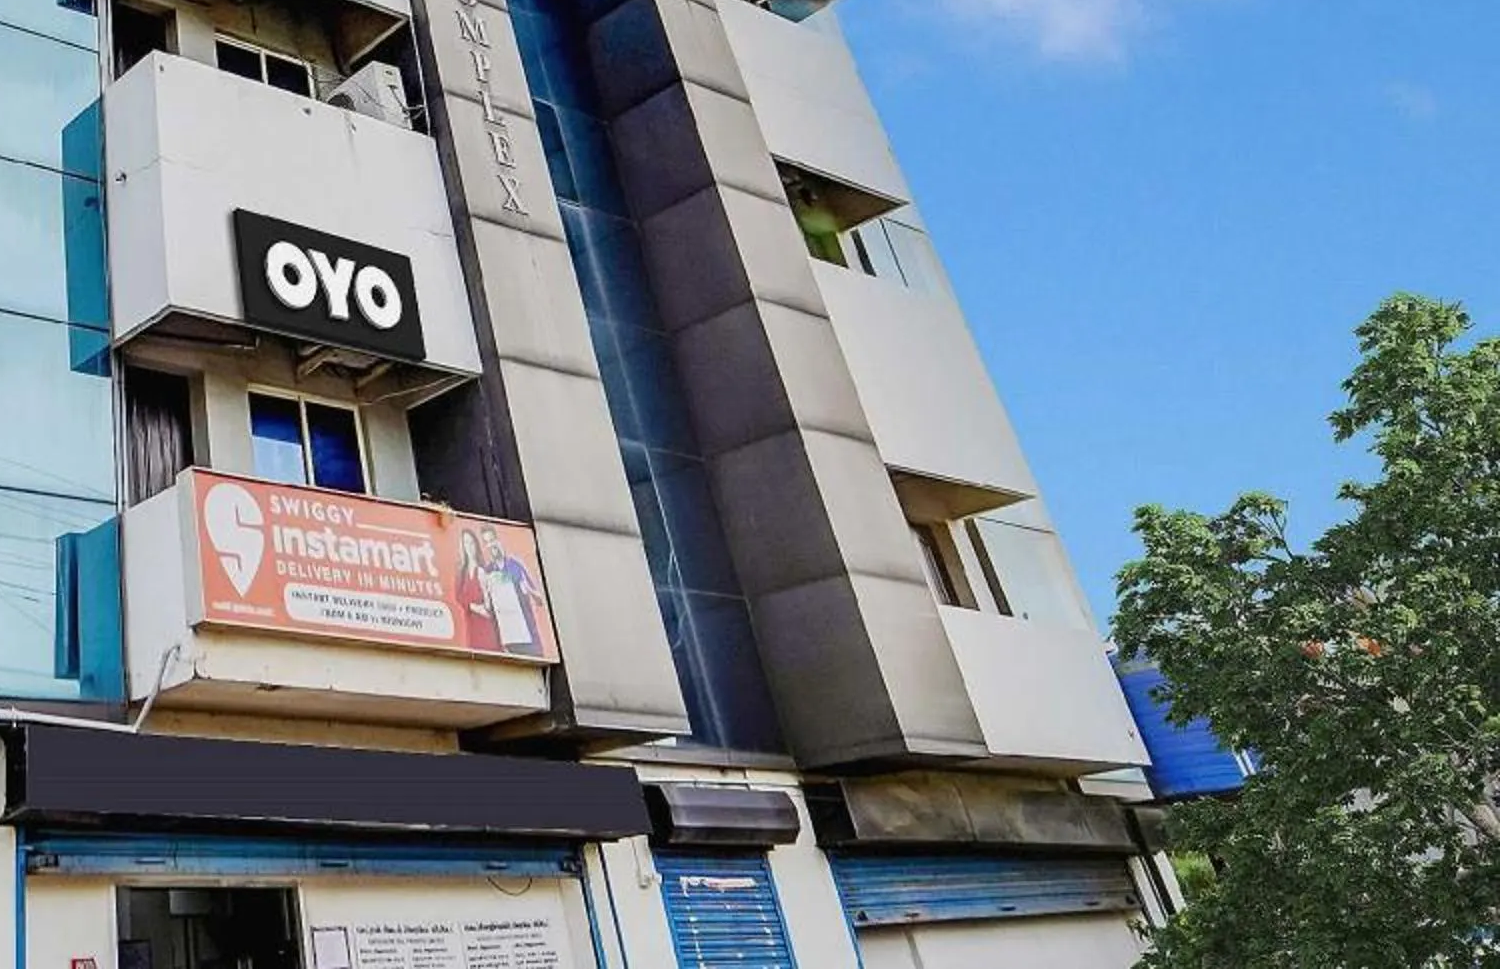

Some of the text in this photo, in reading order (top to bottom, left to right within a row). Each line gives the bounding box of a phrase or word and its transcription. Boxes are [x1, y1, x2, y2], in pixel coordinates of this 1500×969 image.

[264, 240, 403, 330] OYO
[269, 495, 354, 524] SWIGGY
[276, 560, 444, 597] DELIVERY IN MINUTES
